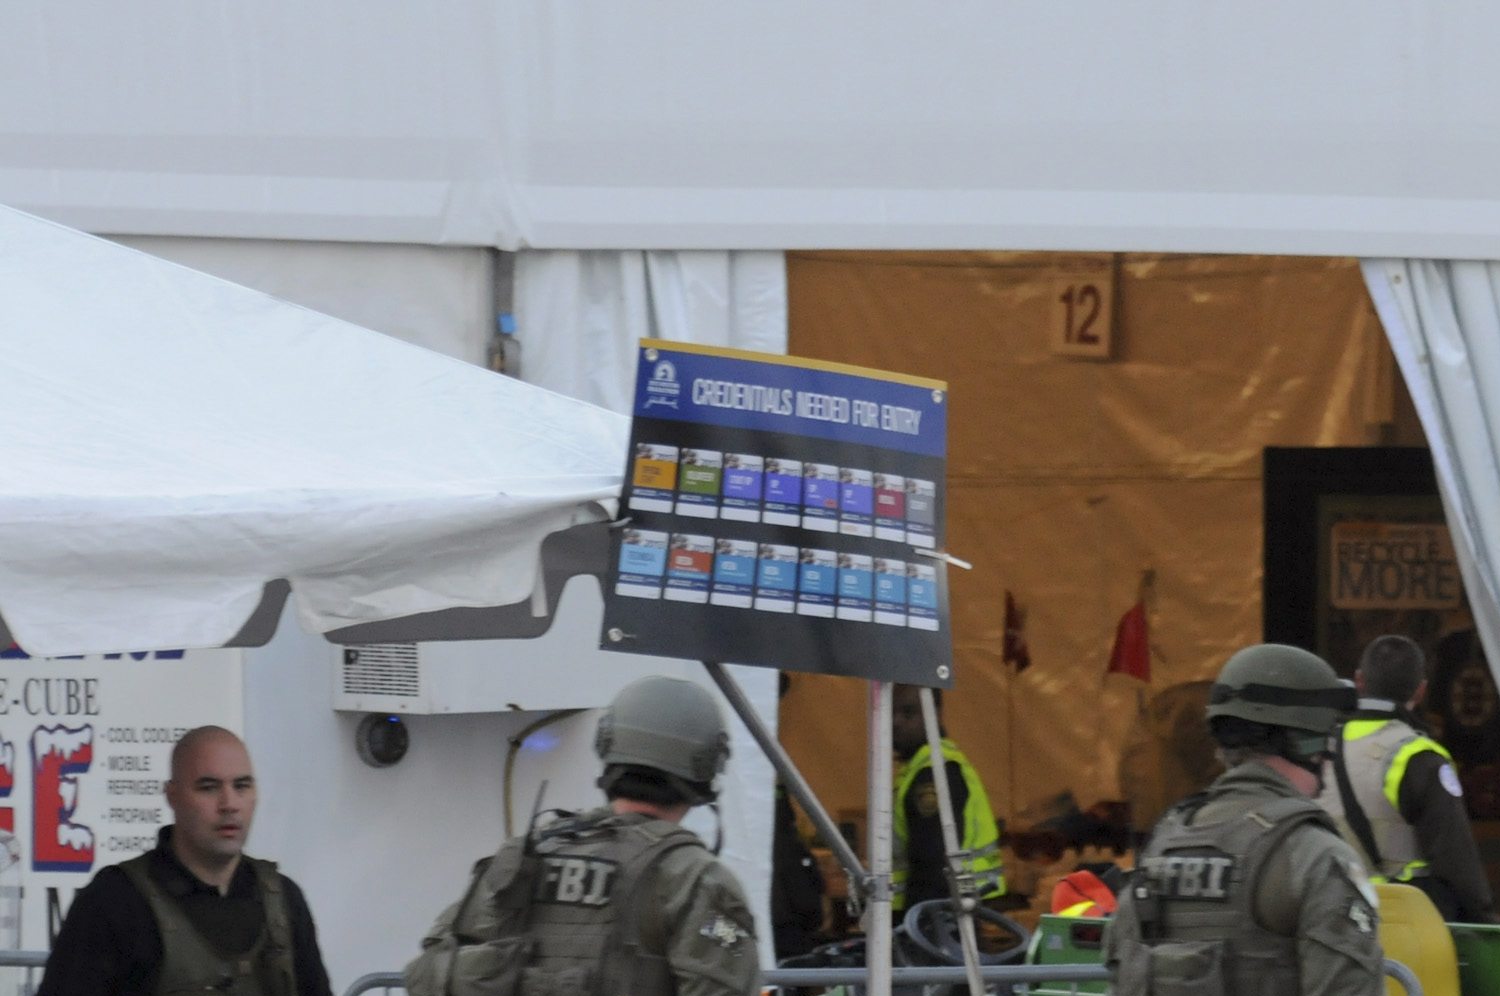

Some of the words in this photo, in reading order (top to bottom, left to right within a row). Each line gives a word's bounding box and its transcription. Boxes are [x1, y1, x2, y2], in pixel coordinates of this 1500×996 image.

[1059, 284, 1101, 345] 12
[692, 378, 793, 416] CREDENTIALS
[795, 391, 849, 424] NEEDED
[852, 400, 880, 429] FOR
[881, 404, 922, 435] ENTRY
[107, 727, 139, 743] COOL
